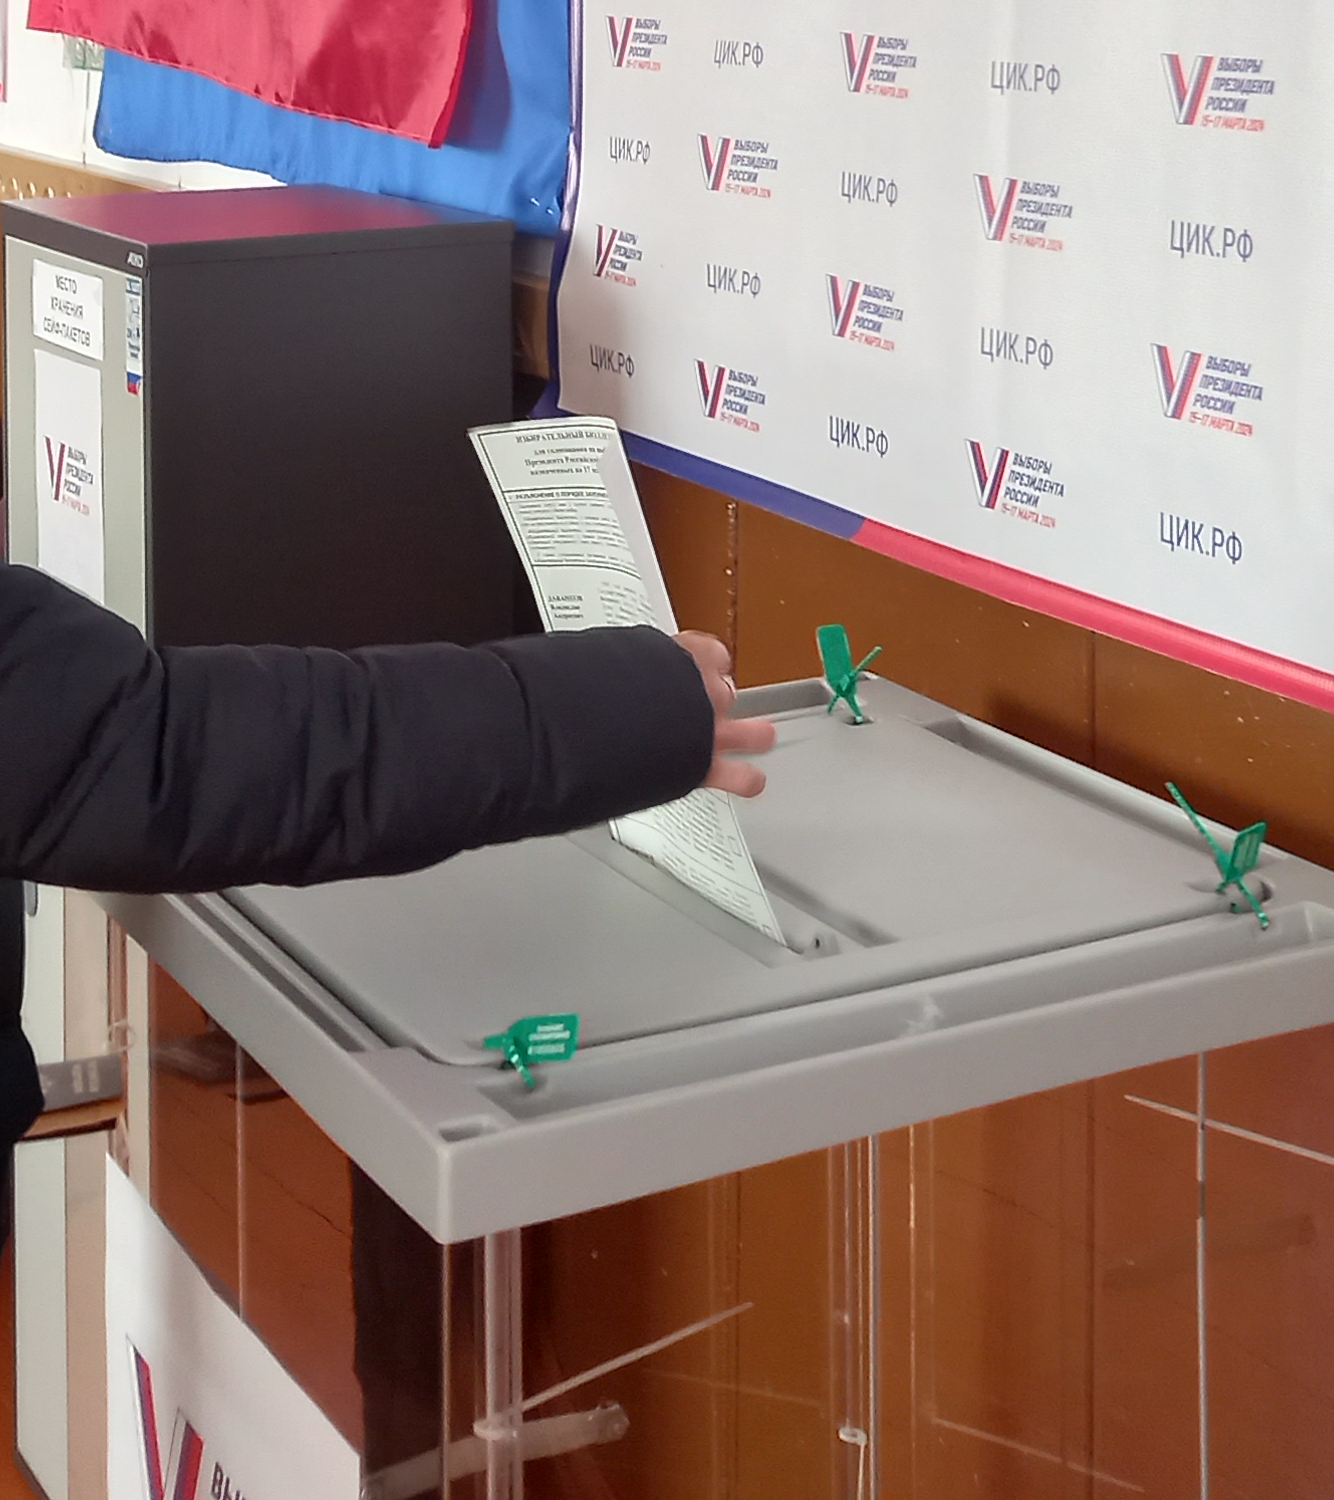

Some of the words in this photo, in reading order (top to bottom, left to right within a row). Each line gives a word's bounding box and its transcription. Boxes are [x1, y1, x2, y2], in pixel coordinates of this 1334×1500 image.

[714, 40, 763, 68] ЦИК.РФ
[1216, 57, 1264, 74] ВЫБОРЫ
[991, 61, 1060, 95] ЦИК.РФ
[610, 136, 650, 165] ЦИК.РФ
[842, 171, 898, 207] ЦИК.РФ
[1170, 220, 1253, 262] ЦИК.РФ
[707, 263, 760, 298] ЦИК.РФ
[590, 345, 634, 378] ЦИК.РФ
[981, 327, 1053, 370] ЦИК.РФ
[1204, 355, 1252, 378] ВЫБОРЫ
[830, 416, 888, 458] ЦИК.РФ
[1160, 512, 1242, 564] ЦИК.РФ
